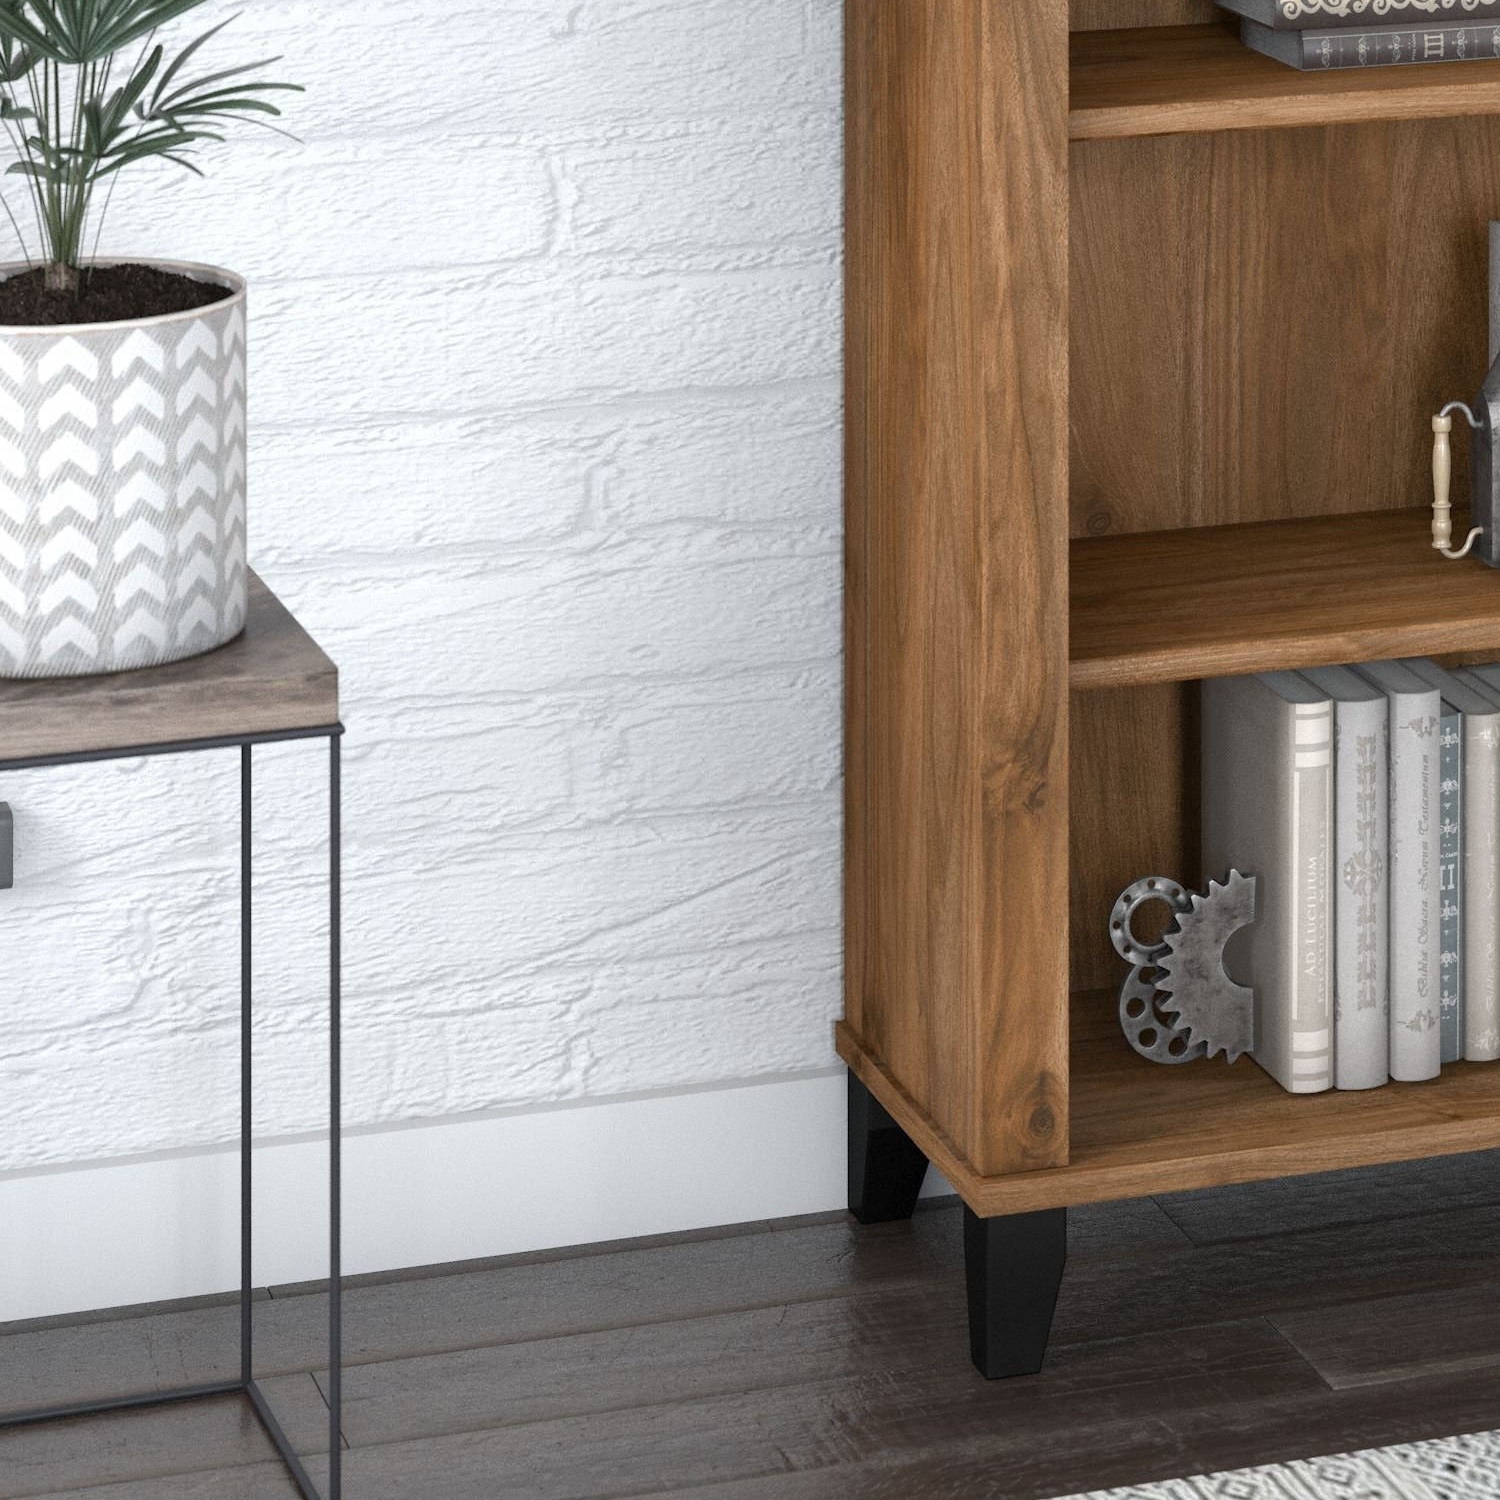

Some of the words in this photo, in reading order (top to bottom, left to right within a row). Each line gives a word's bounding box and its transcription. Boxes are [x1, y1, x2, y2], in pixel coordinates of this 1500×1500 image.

[1424, 33, 1444, 58] III
[1306, 856, 1317, 944] LUCILIUM
[1305, 952, 1316, 977] AD
